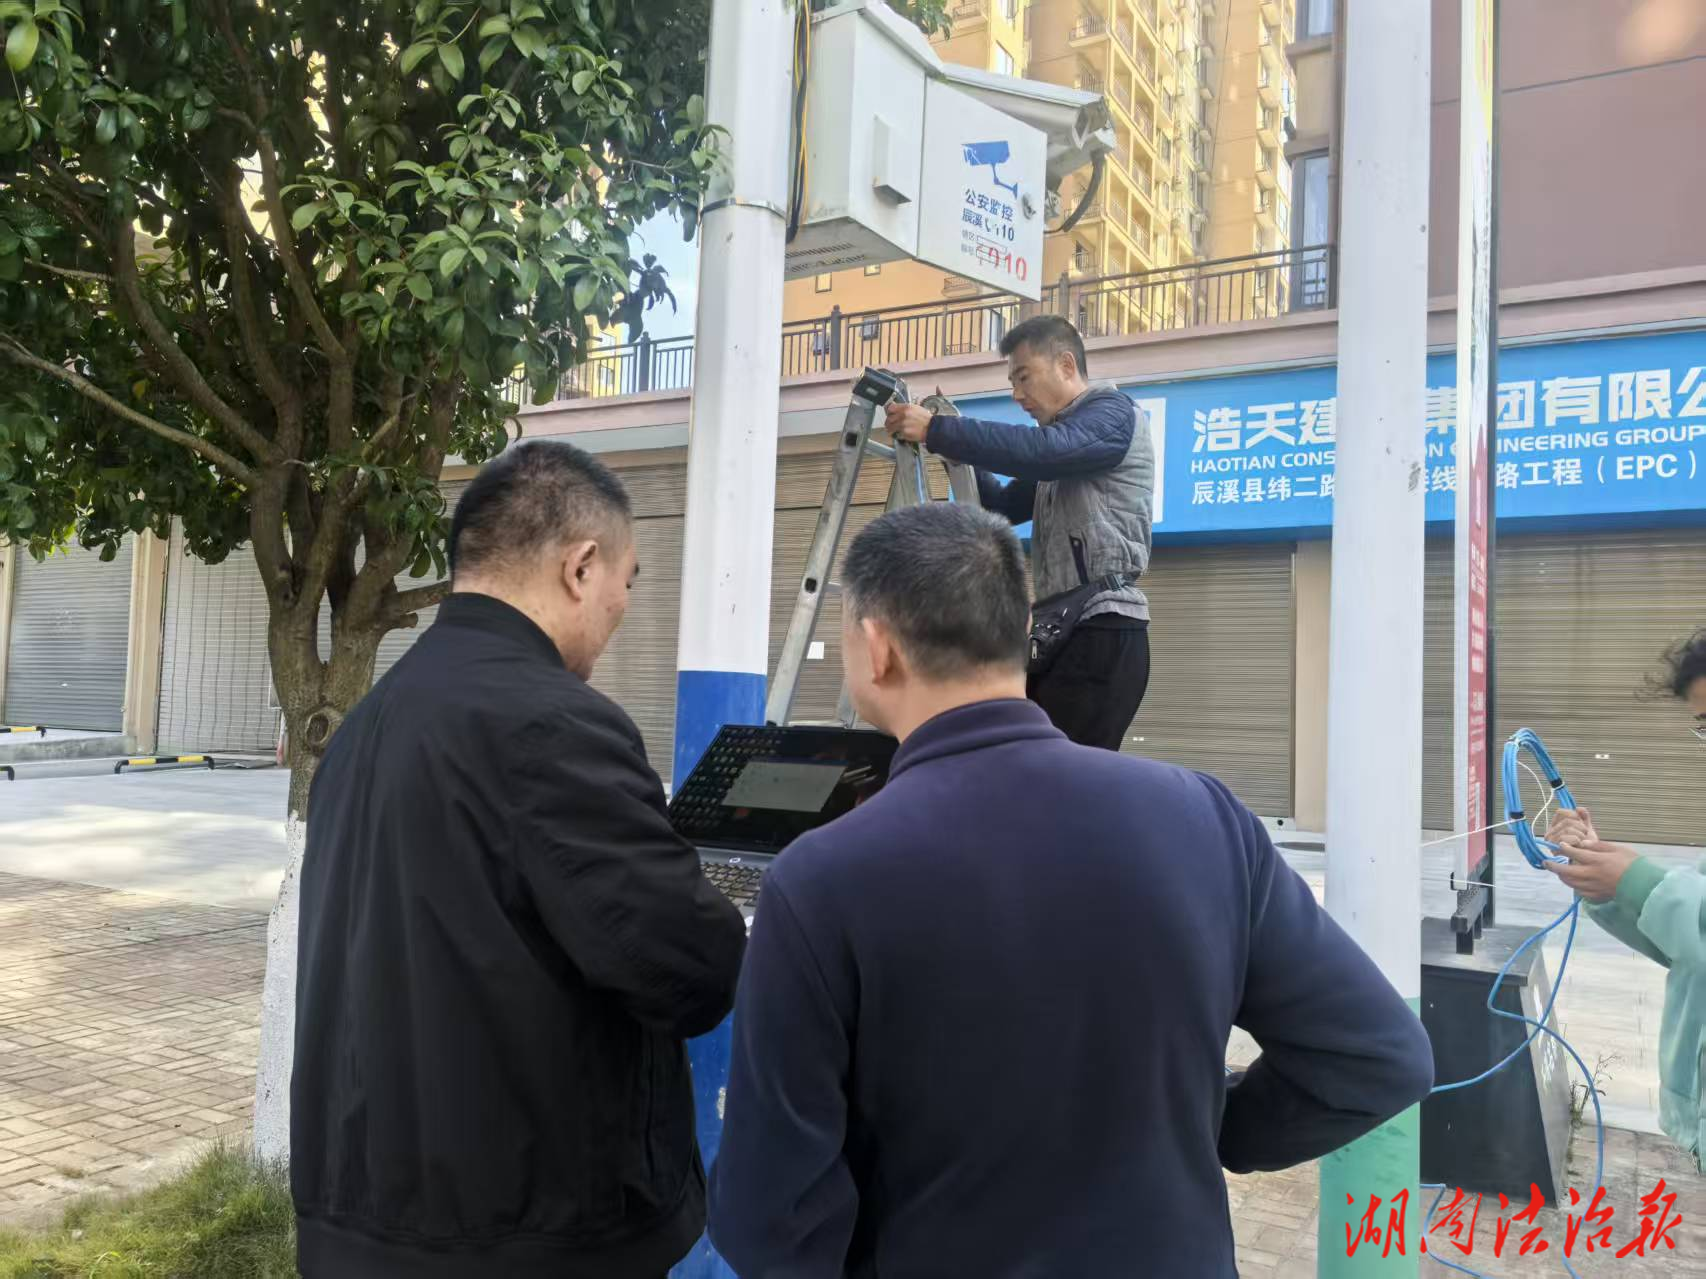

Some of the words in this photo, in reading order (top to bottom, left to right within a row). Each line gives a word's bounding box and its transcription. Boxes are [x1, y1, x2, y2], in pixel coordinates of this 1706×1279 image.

[965, 188, 1014, 222] 公安监控
[1190, 454, 1276, 474] HAOTIAN
[1615, 424, 1706, 446] GROUP
